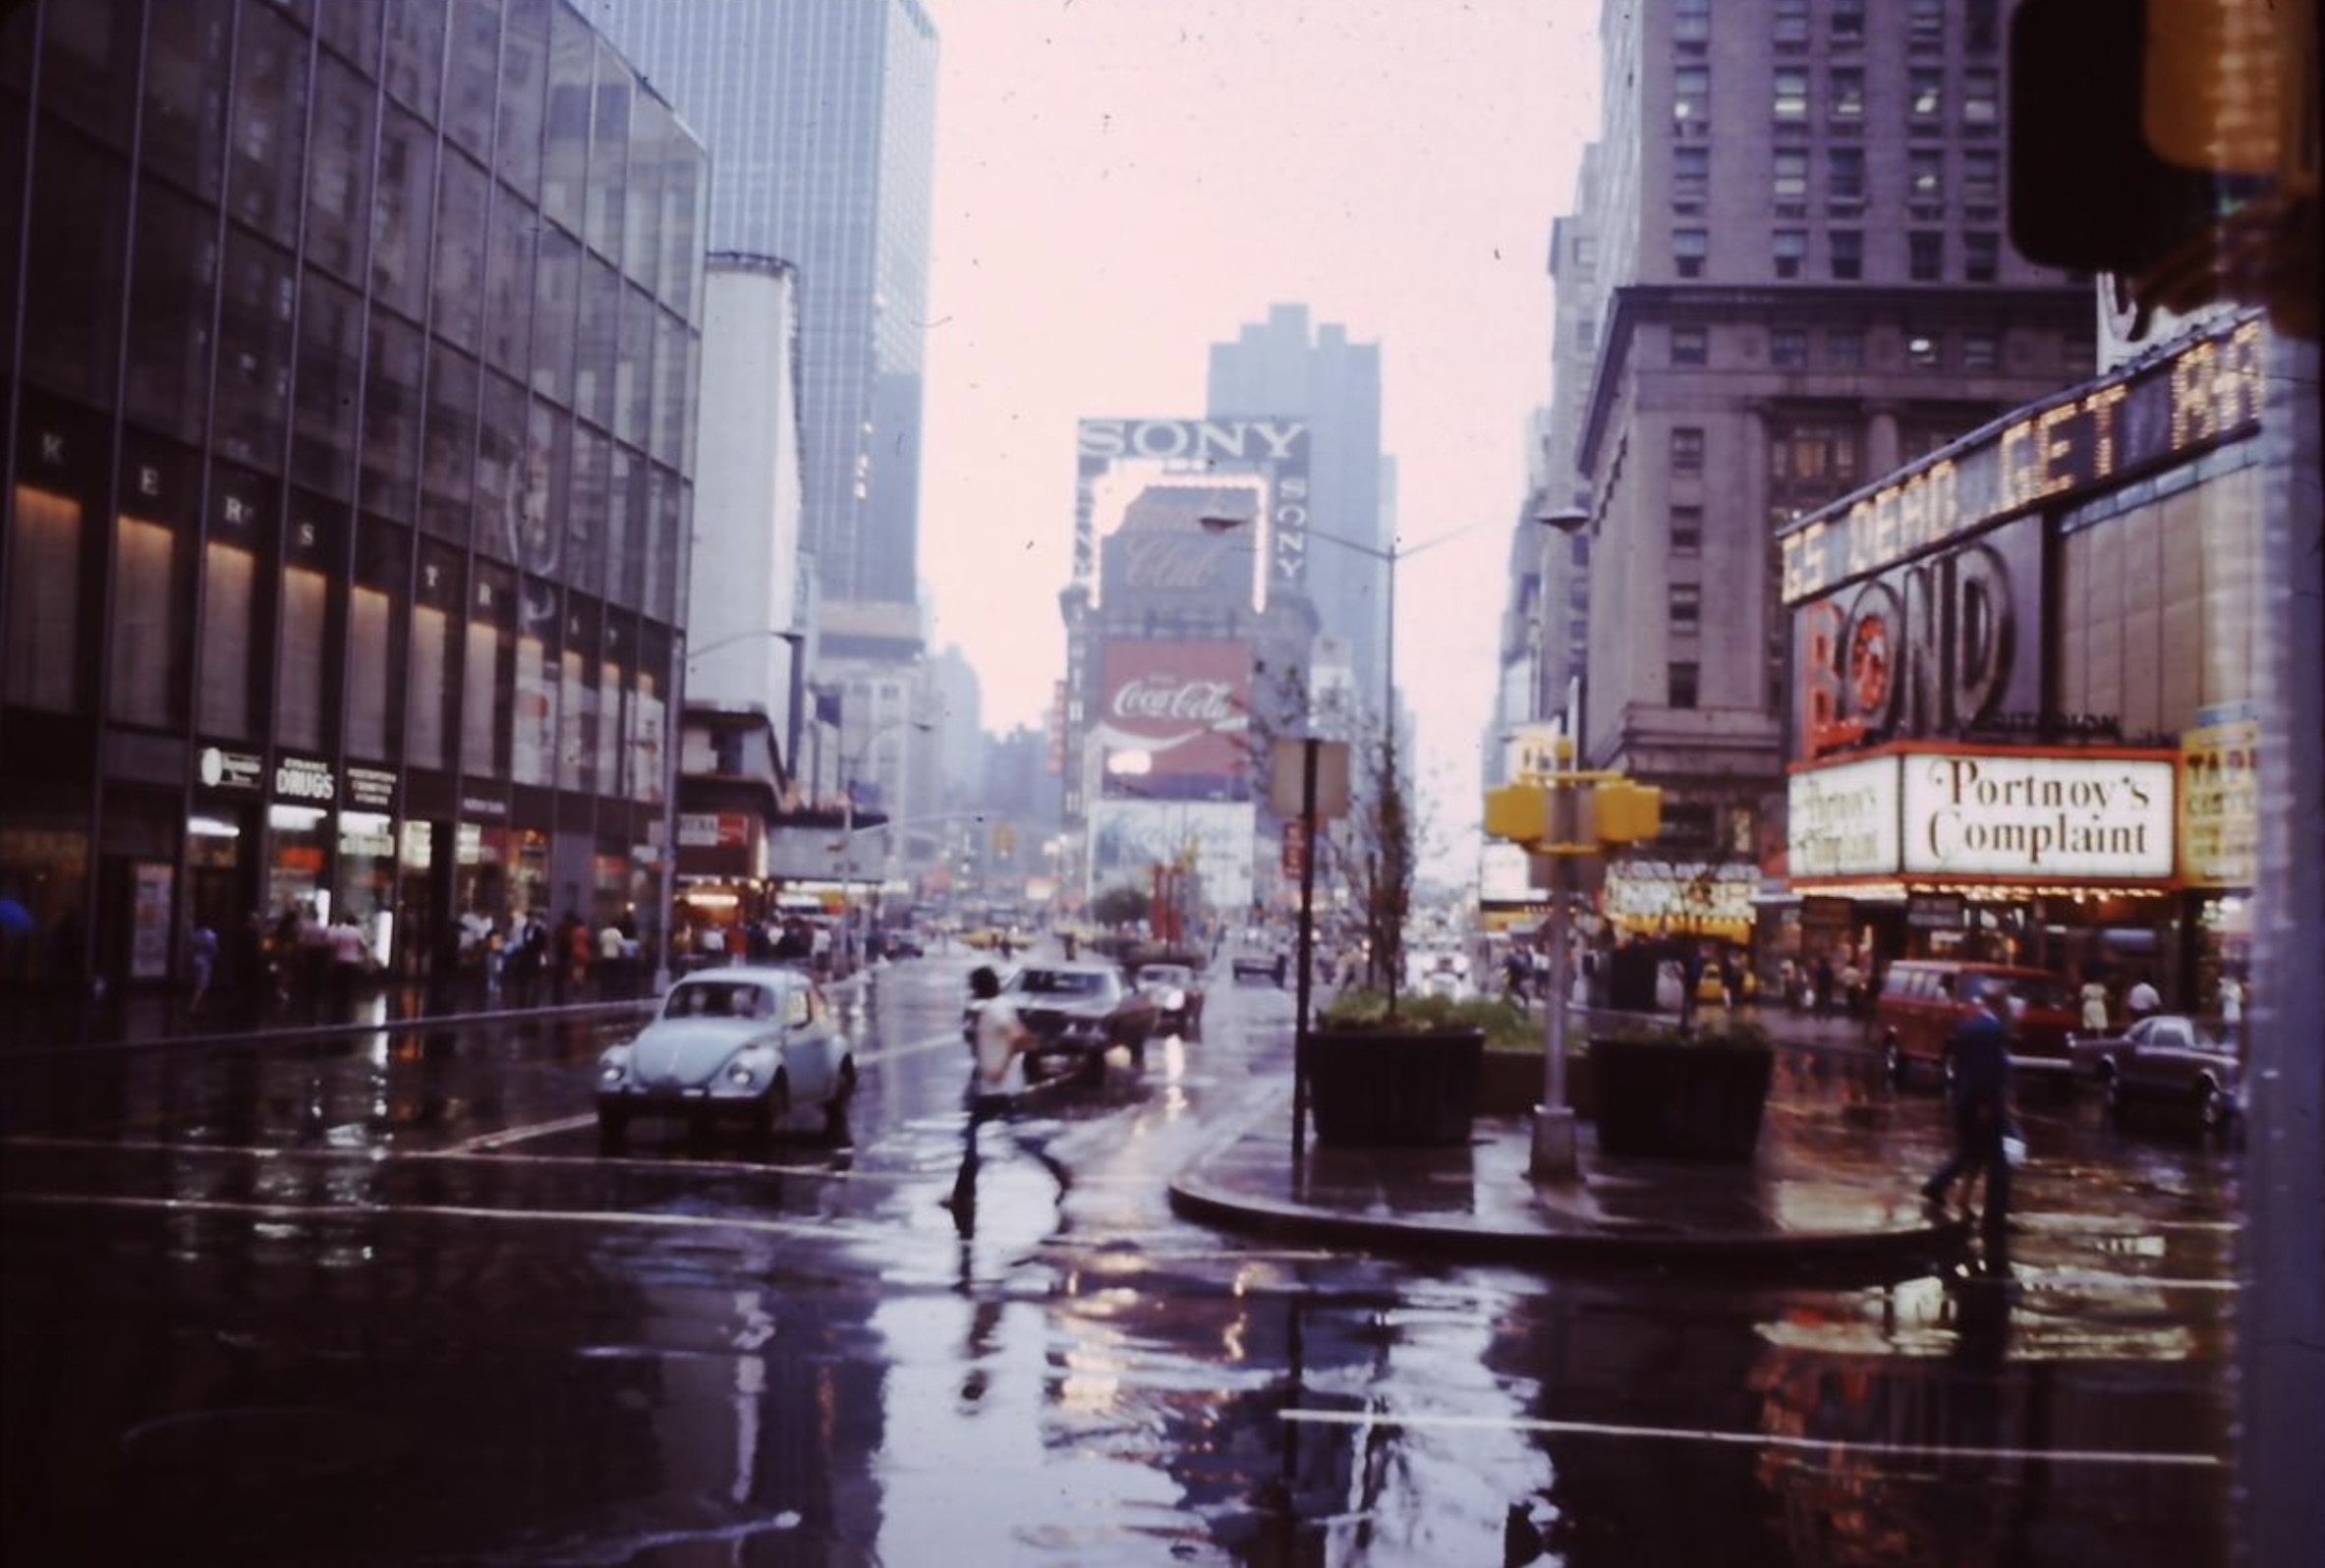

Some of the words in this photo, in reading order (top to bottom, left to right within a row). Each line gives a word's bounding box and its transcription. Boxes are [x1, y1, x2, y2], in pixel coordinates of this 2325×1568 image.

[1078, 420, 1306, 459] SONY
[1277, 477, 1307, 579] SONY
[1804, 540, 2015, 759] BOND
[276, 767, 334, 800] DRUGS
[1928, 756, 2149, 808] Portnoy's
[1928, 809, 2147, 864] Complaint
